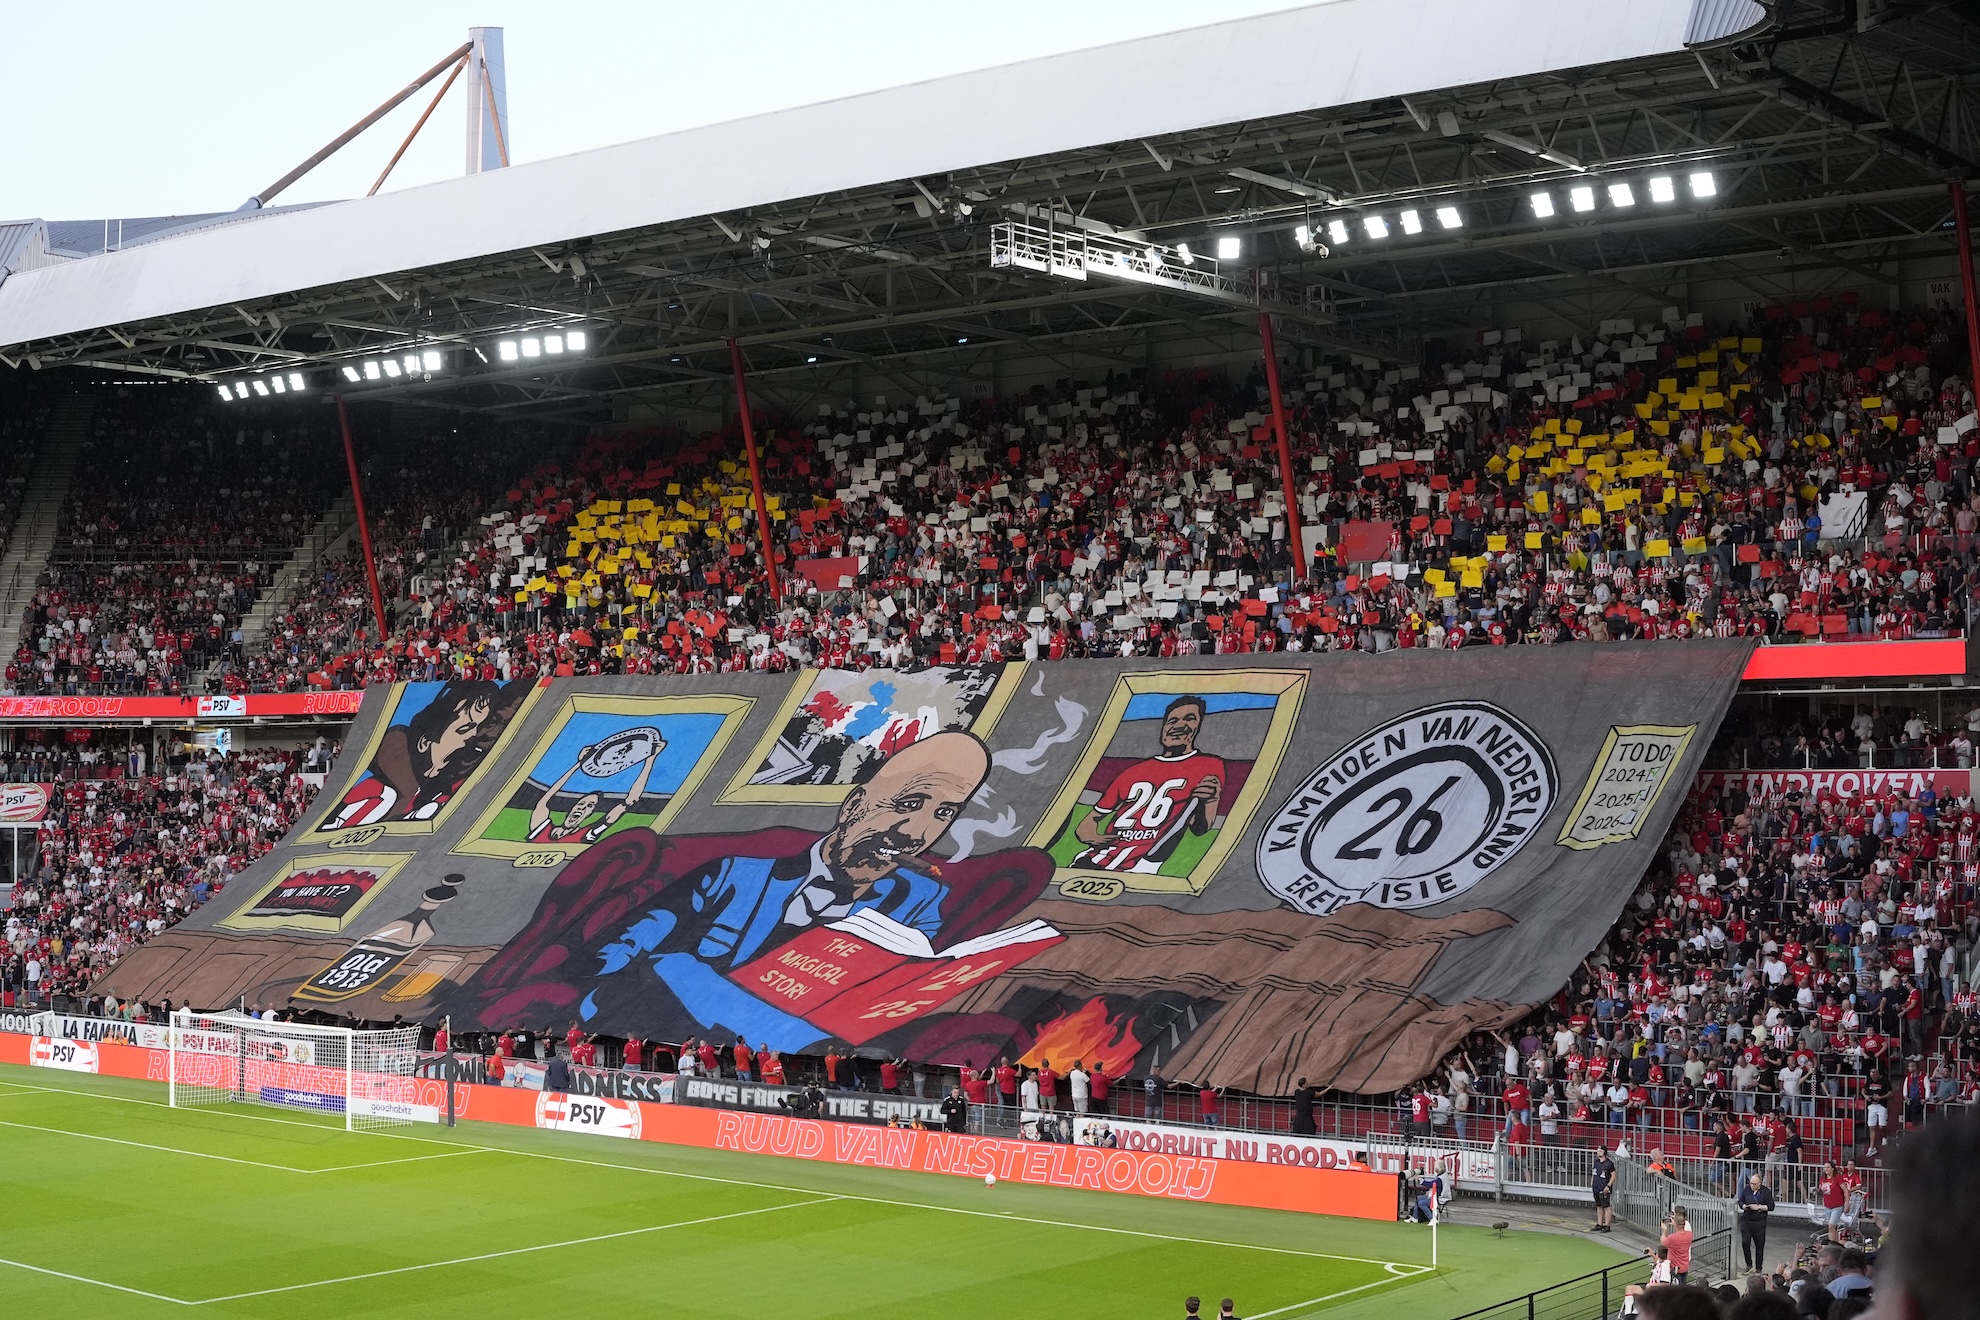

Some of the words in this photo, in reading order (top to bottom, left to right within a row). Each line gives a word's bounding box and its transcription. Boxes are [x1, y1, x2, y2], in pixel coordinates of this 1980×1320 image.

[1931, 282, 1950, 294] VAK
[213, 700, 230, 711] PSV
[1619, 743, 1645, 761] TO
[1605, 768, 1645, 782] 2024
[1269, 729, 1406, 852] KAMPIOEN
[1422, 716, 1479, 743] VAN
[1477, 724, 1541, 869] NEDERLAND
[1722, 773, 1935, 800] EINDHOVEN
[6, 795, 26, 805] PSV
[1114, 779, 1187, 828] 26
[1335, 776, 1461, 860] 26
[1582, 814, 1622, 831] 2026
[335, 828, 379, 845] 2007
[521, 853, 558, 866] 2016
[279, 888, 297, 898] YOU
[295, 886, 324, 897] HAVE
[322, 885, 351, 898] IT?
[1066, 880, 1118, 896] 2025
[823, 938, 864, 958] THE
[340, 953, 391, 973] Old
[777, 949, 849, 986] MAGICAL
[318, 968, 370, 988] 1913
[759, 969, 812, 1000] STORY
[63, 1019, 78, 1039] LA
[182, 1033, 204, 1050] PSV
[53, 1045, 75, 1062] PSV
[147, 1050, 221, 1086] RUUD
[228, 1058, 281, 1092] VAN
[543, 1067, 661, 1103] ADNESS
[284, 1092, 322, 1104] goodhabitz
[686, 1080, 738, 1104] BOYS
[827, 1097, 868, 1118] THE
[371, 1104, 412, 1115] goodhabitz
[570, 1103, 606, 1125] PSV
[1115, 1128, 1217, 1158] VOORUIT
[1225, 1139, 1258, 1162] NU
[715, 1112, 824, 1158] RUUD
[834, 1125, 917, 1168] VAN
[923, 1133, 1217, 1199] NISTELROOIJ
